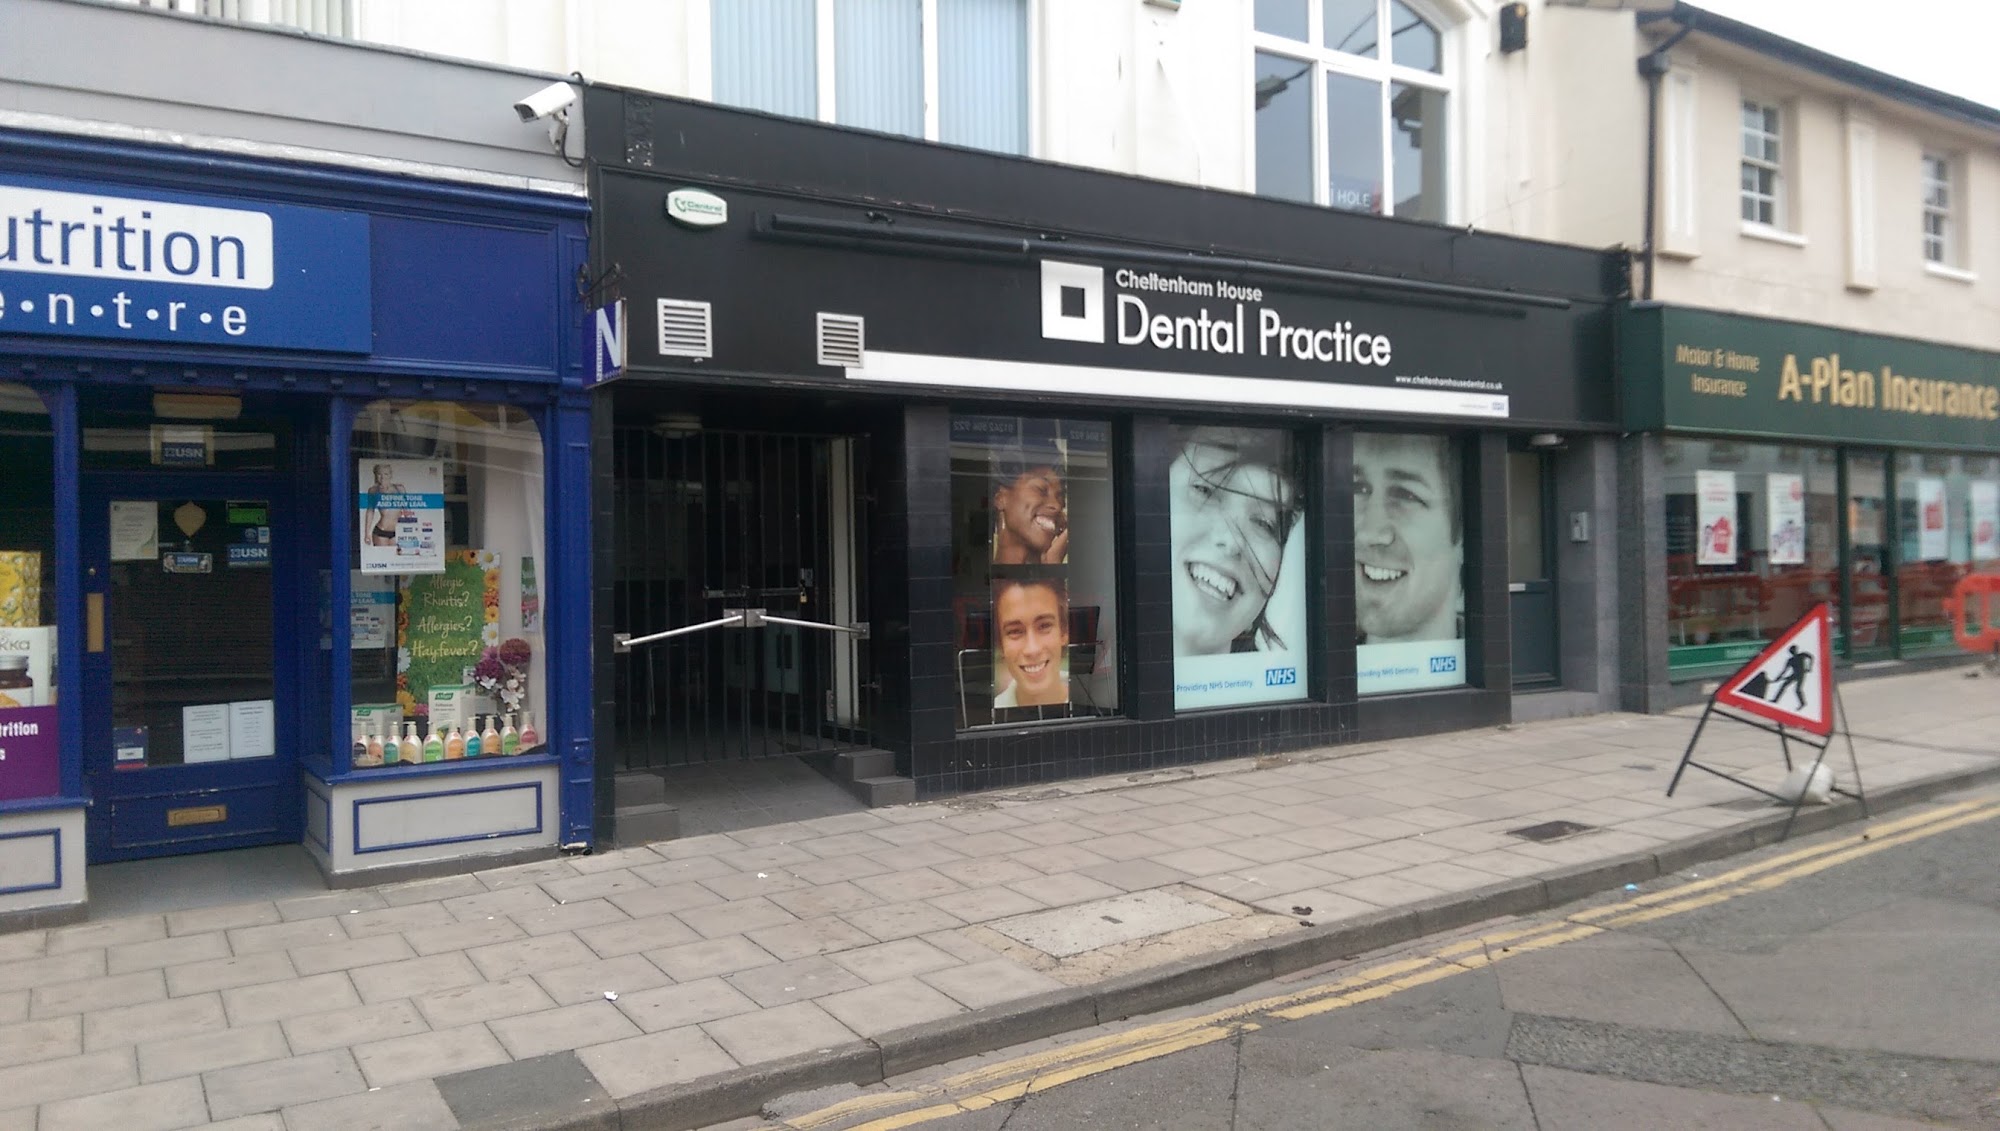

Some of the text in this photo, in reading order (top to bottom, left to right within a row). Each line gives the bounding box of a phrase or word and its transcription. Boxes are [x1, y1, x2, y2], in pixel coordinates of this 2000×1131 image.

[1115, 268, 1263, 302] Cheltenham House
[1116, 293, 1391, 367] Dental Practice
[1675, 344, 1761, 374] Motor & Home
[1394, 375, 1504, 391] www.cheltenhamhousedental.co.uk
[1691, 372, 1748, 399] Insurance
[1777, 353, 2000, 421] A-Plan Insurance
[241, 547, 269, 559] USN
[416, 615, 473, 639] Allergies?
[1430, 656, 1456, 673] NHS
[1176, 679, 1254, 692] Providing NHS Dentistry
[1266, 668, 1295, 686] NHS
